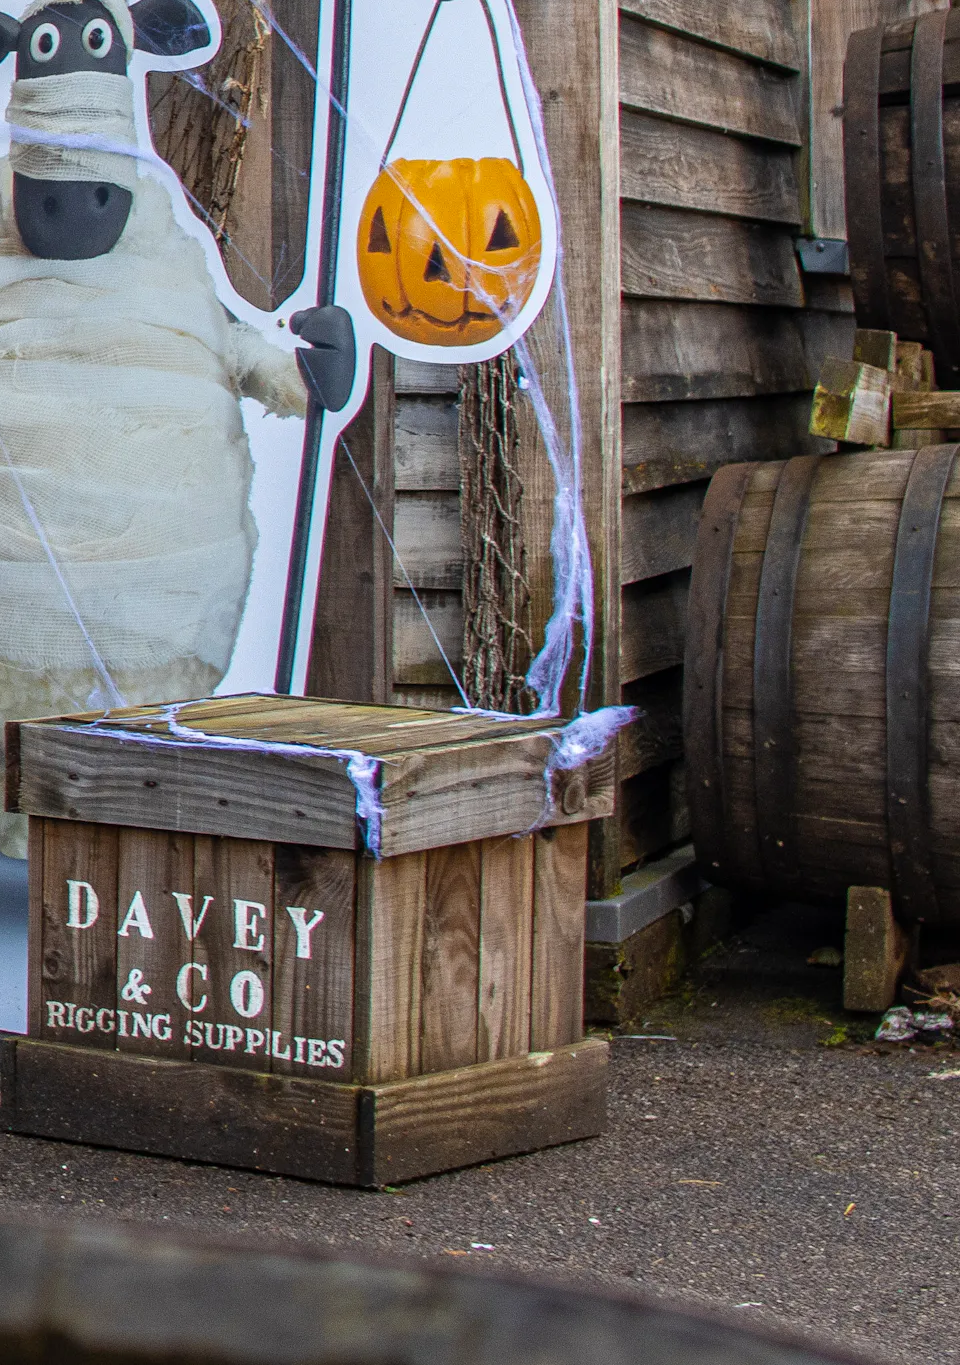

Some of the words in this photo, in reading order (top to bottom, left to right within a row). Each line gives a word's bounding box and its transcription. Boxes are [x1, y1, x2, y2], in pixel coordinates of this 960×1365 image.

[66, 879, 325, 960] DAVEY
[121, 968, 152, 1005] &
[176, 962, 265, 1018] CO
[46, 1000, 173, 1041] RIGGING
[184, 1019, 346, 1069] SUPPLIES
